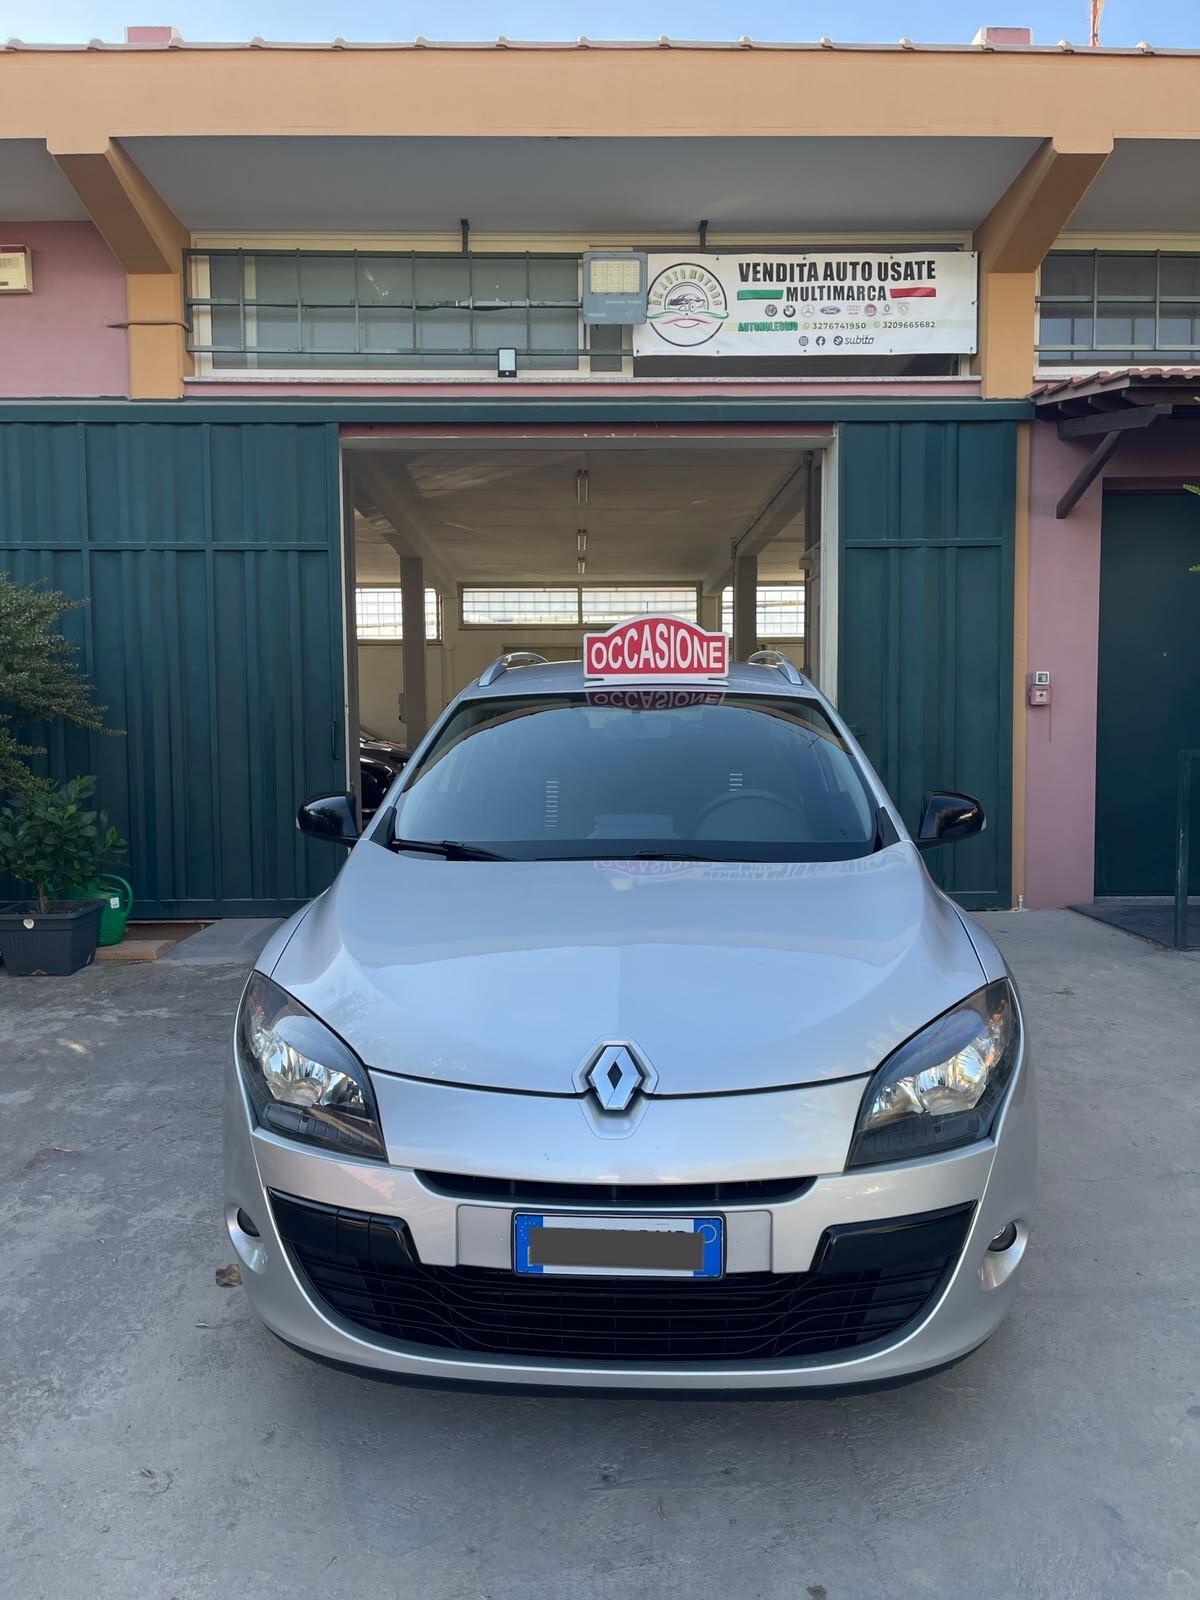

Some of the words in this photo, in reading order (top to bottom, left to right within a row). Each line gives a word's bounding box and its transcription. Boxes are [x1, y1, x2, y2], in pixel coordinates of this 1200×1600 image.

[738, 261, 819, 283] VENDITA
[822, 261, 873, 282] AUTO
[877, 260, 936, 281] USATE
[786, 285, 887, 302] MULTIMARCA
[811, 322, 867, 330] 3276741950
[882, 321, 936, 329] 3209665682
[844, 334, 875, 345] subito
[591, 623, 723, 669] OCCASIONE
